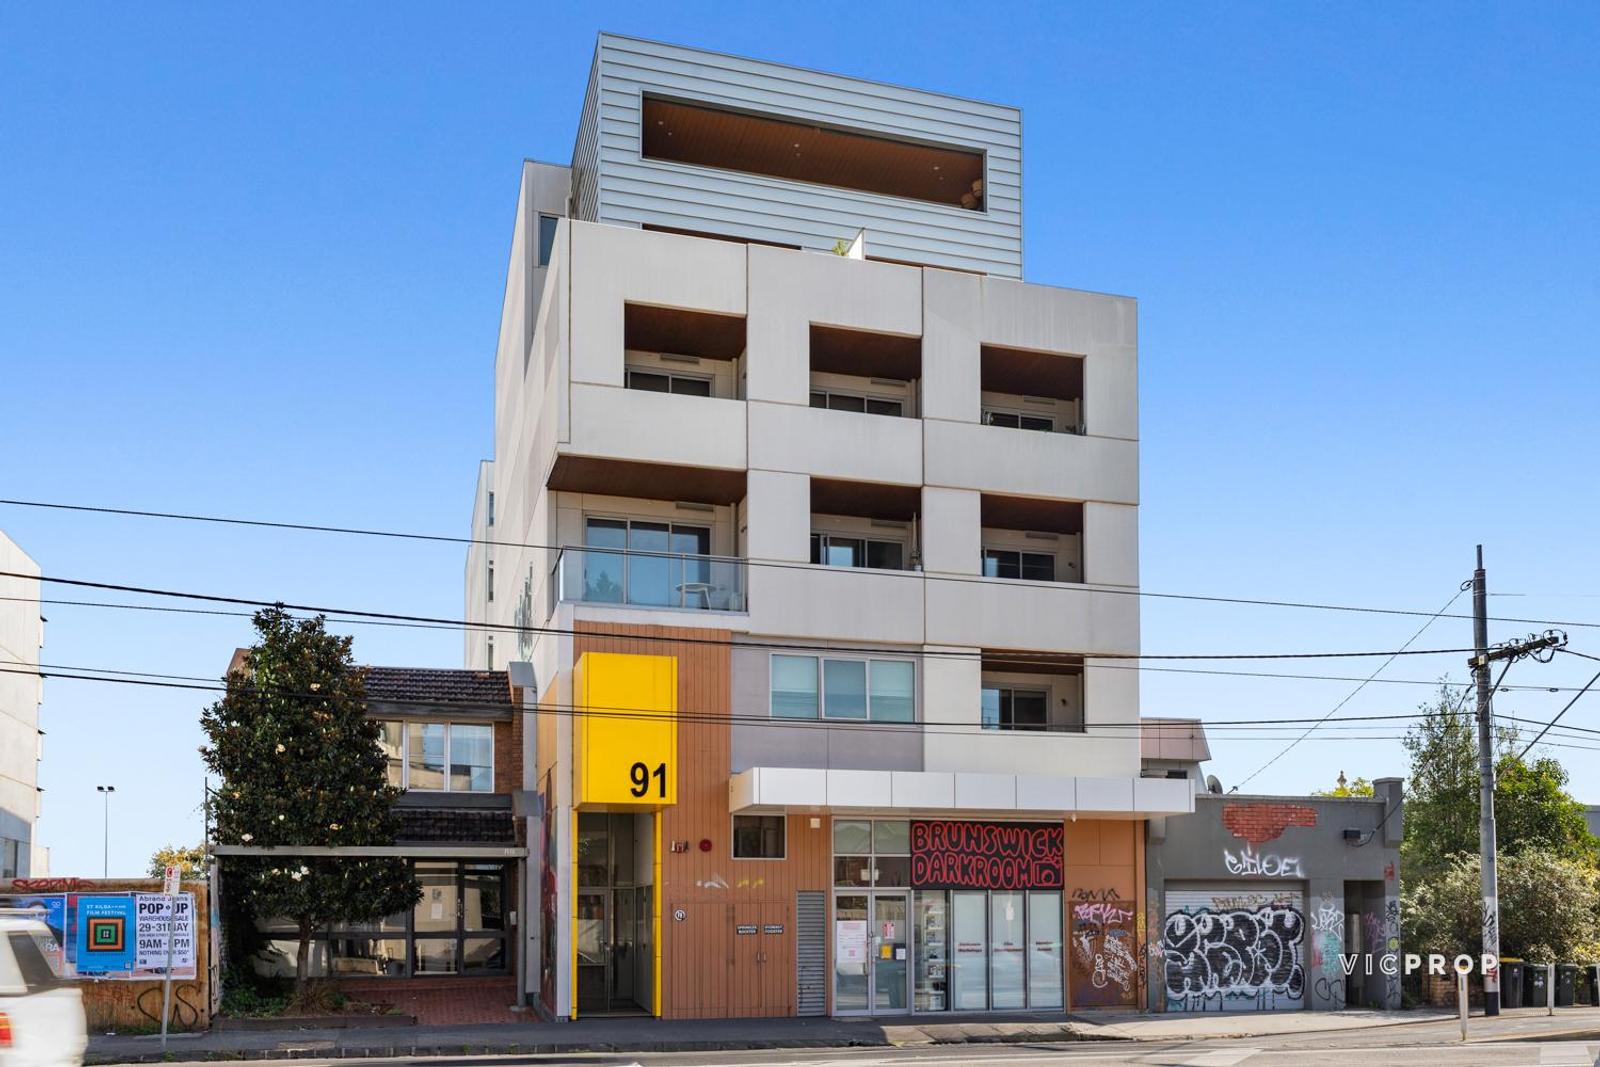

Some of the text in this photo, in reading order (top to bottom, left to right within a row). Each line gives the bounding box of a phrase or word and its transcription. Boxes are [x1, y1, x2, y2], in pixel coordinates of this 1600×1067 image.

[630, 761, 666, 798] 91
[912, 822, 1063, 858] BRUNSWICK
[912, 852, 1032, 888] DARKROOM
[139, 903, 164, 915] POP
[139, 922, 167, 933] 29-31
